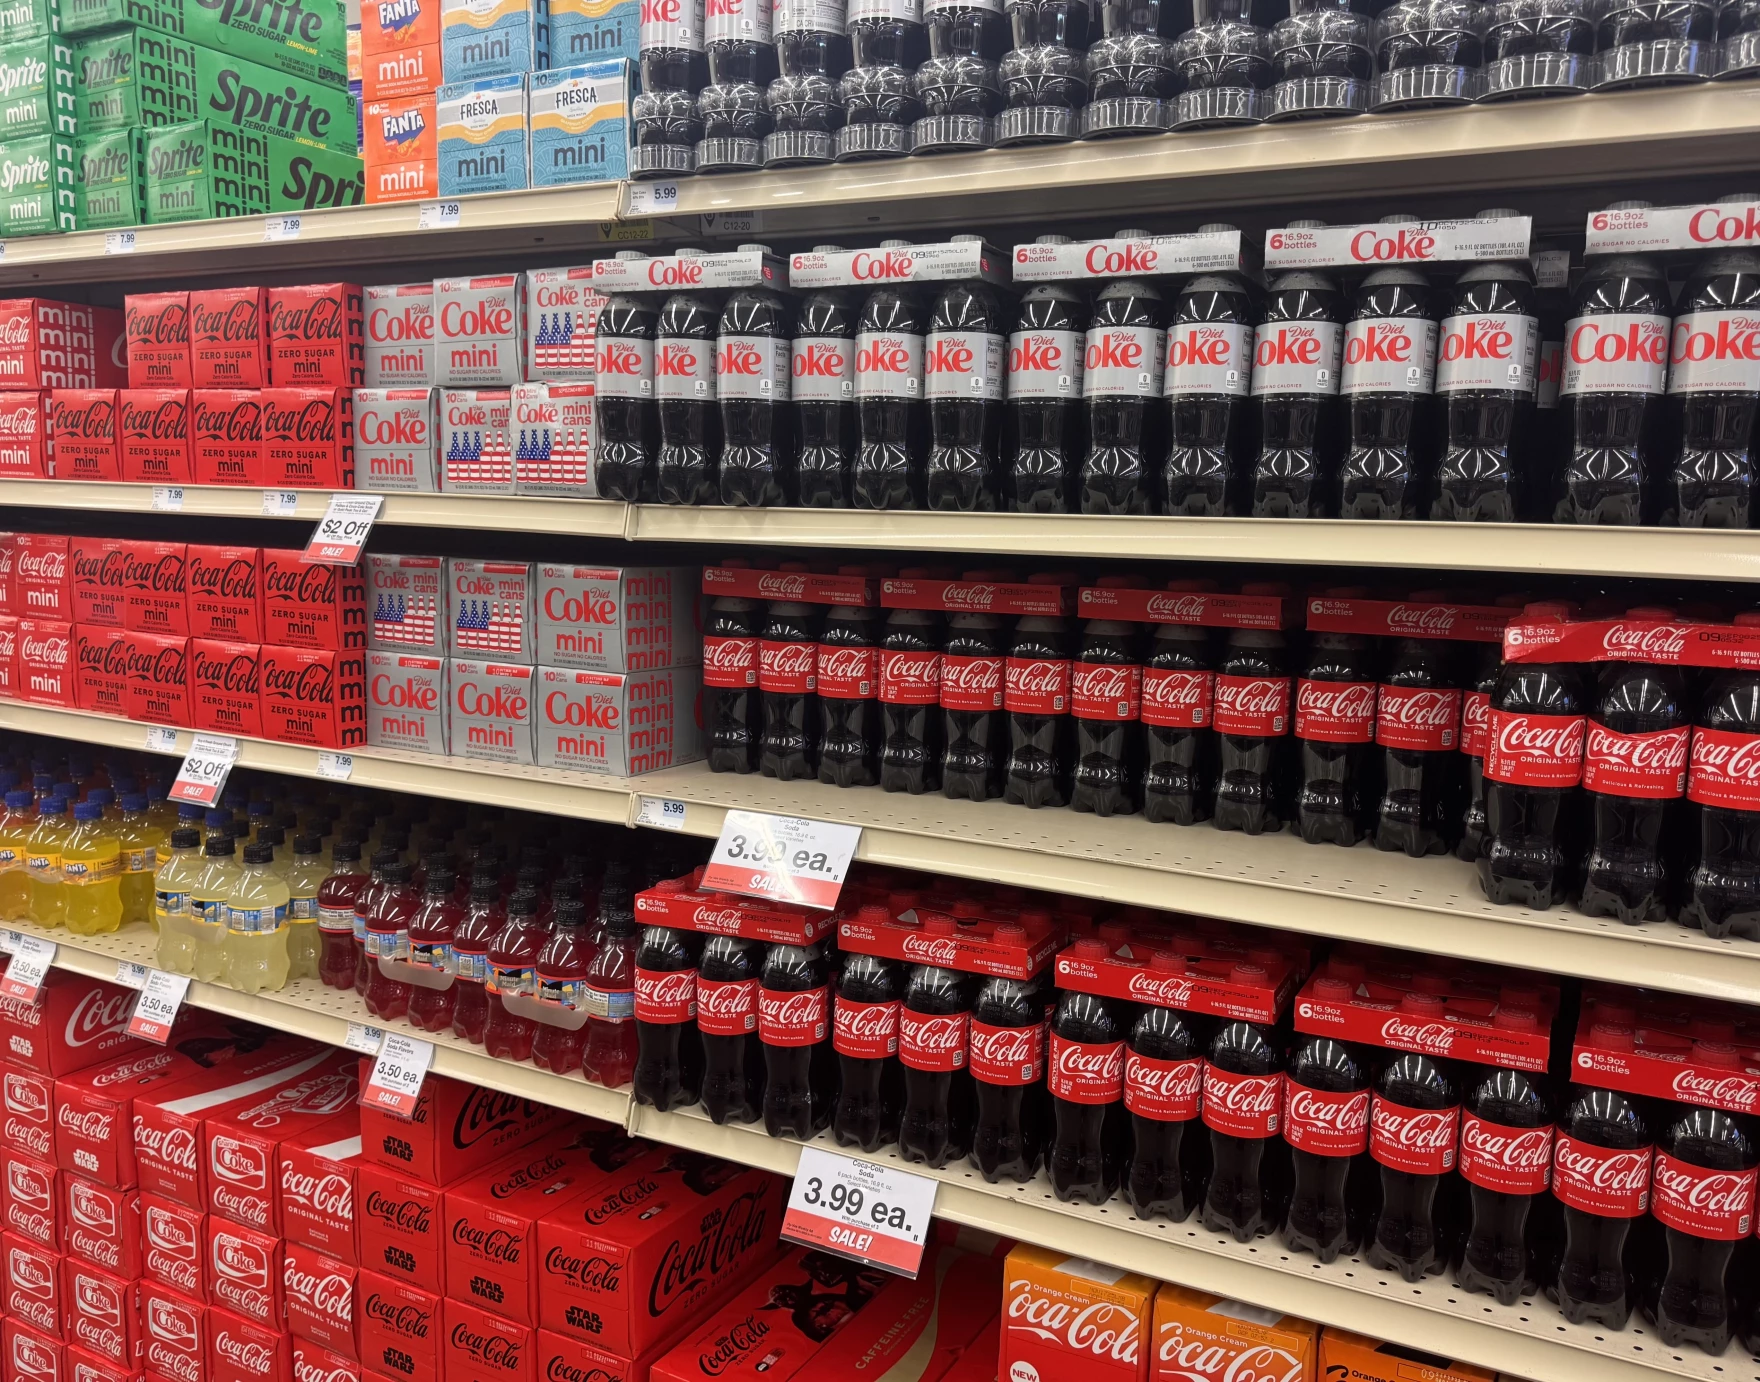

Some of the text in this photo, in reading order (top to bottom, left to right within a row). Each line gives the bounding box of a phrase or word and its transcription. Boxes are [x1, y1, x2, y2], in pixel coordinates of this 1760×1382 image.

[231, 21, 287, 44] ZERO SUGAR
[139, 36, 195, 67] mini
[140, 60, 196, 92] mini
[535, 74, 547, 86] 10
[210, 70, 331, 137] Sprite
[556, 86, 597, 109] FRESCA
[460, 98, 498, 120] FRESCA
[243, 119, 295, 141] ZERO SUGAR
[383, 109, 424, 138] FANTA
[212, 127, 268, 157] mini
[149, 140, 204, 180] Sprite
[554, 137, 605, 167] mini
[458, 149, 505, 178] mini
[1, 156, 49, 192] Sprite
[380, 164, 424, 192] mini
[654, 186, 677, 199] 5.99
[10, 196, 41, 219] mini
[440, 205, 459, 216] 7.99
[1592, 213, 1608, 230] 6
[1610, 212, 1644, 221] 16.9oz
[283, 219, 300, 231] 7.99
[723, 221, 750, 231] C12-20
[1407, 228, 1429, 237] Diet
[1609, 220, 1648, 230] bottles
[617, 229, 649, 240] CC12-22
[1270, 234, 1283, 250] 6
[1284, 232, 1313, 241] 16.9oz
[1134, 241, 1153, 250] Diet
[1284, 240, 1317, 249] bottles
[1350, 229, 1435, 262] Coke
[684, 257, 699, 266] Diet
[893, 250, 908, 259] Diet
[1085, 245, 1158, 274] Coke
[595, 261, 604, 275] 6
[648, 260, 702, 286] Coke
[852, 252, 913, 281] Coke
[486, 296, 507, 309] Diet
[38, 305, 93, 328] mini
[440, 301, 513, 337] Coke
[1641, 321, 1664, 334] Diet
[1570, 323, 1667, 364] Coke
[278, 349, 335, 358] ZERO SUGAR
[451, 343, 498, 367] mini
[294, 359, 321, 373] mini
[401, 408, 421, 420] Diet
[516, 402, 558, 424] Coke
[562, 401, 592, 416] mini
[359, 411, 426, 445] Coke
[562, 415, 592, 426] cans
[270, 450, 327, 459] ZERO SUGAR
[286, 461, 313, 474] mini
[370, 452, 414, 476] mini
[281, 493, 296, 504] 7.99
[323, 519, 369, 536] $2 Off
[321, 547, 344, 556] SALE!
[17, 550, 66, 579] Coca-Cola
[589, 587, 610, 599] Diet
[1081, 590, 1092, 603] 6
[1092, 596, 1118, 605] bottles
[1093, 590, 1115, 598] 16.9oz
[544, 587, 617, 625] Coke
[1147, 593, 1208, 616] Coca-Cola
[1508, 629, 1523, 645] 6
[1523, 626, 1556, 637] 16.9oz
[1523, 634, 1560, 645] bottles
[1603, 624, 1685, 653] Coca-Cola
[556, 630, 603, 653] mini
[1607, 649, 1679, 660] ORIGINAL TASTE
[271, 705, 327, 720] ZERO SUGAR
[286, 717, 313, 733] mini
[1587, 729, 1686, 768] Coca-Cola
[186, 758, 225, 777] $2 Off
[335, 755, 352, 766] 7.99
[1599, 762, 1671, 775] ORIGINAL TASTE
[183, 786, 203, 796] SALE!
[663, 802, 684, 814] 5.99
[64, 863, 88, 875] FANTA
[793, 849, 832, 873] ea.
[12, 959, 41, 978] 3.50 ea.
[10, 984, 26, 995] SALE!
[1299, 1003, 1312, 1018] 6
[1313, 1004, 1341, 1015] 16.9oz
[1313, 1012, 1345, 1024] bottles
[365, 1027, 380, 1038] 3.99
[1381, 1017, 1453, 1048] Coca-Cola
[389, 1037, 411, 1047] Coca-Cola
[1385, 1039, 1449, 1054] ORIGINAL TASTE
[399, 1046, 414, 1055] Flavors
[1578, 1052, 1592, 1068] 6
[1593, 1054, 1626, 1066] 16.9oz
[378, 1062, 418, 1084] 3.50 ea.
[1593, 1063, 1630, 1075] bottles
[1673, 1070, 1757, 1104] Coca-Cola
[378, 1092, 401, 1106] SALE!
[1676, 1093, 1752, 1112] ORIGINAL TASTE
[58, 1103, 110, 1140] Coca-Cola
[73, 1149, 96, 1160] STAR
[220, 1148, 254, 1173] Coke
[73, 1157, 99, 1172] WARS
[853, 1159, 884, 1173] Coca-Cola
[859, 1169, 874, 1178] Soda
[213, 1185, 267, 1224] Coca-Cola
[804, 1177, 864, 1216] 3.99
[871, 1202, 912, 1232] ea.
[453, 1217, 521, 1264] Coca-Cola
[829, 1226, 874, 1252] SALE!
[648, 1180, 766, 1319] Coca-Cola
[545, 1245, 620, 1292] Coca-Cola
[469, 1275, 499, 1291] STAR
[470, 1288, 504, 1304] WARS
[1033, 1283, 1090, 1305] Orange Cream
[565, 1305, 598, 1322] STAR
[565, 1318, 603, 1334] WARS
[855, 1297, 930, 1370] CAFFEINE FREE
[1012, 1367, 1038, 1380] NEW
